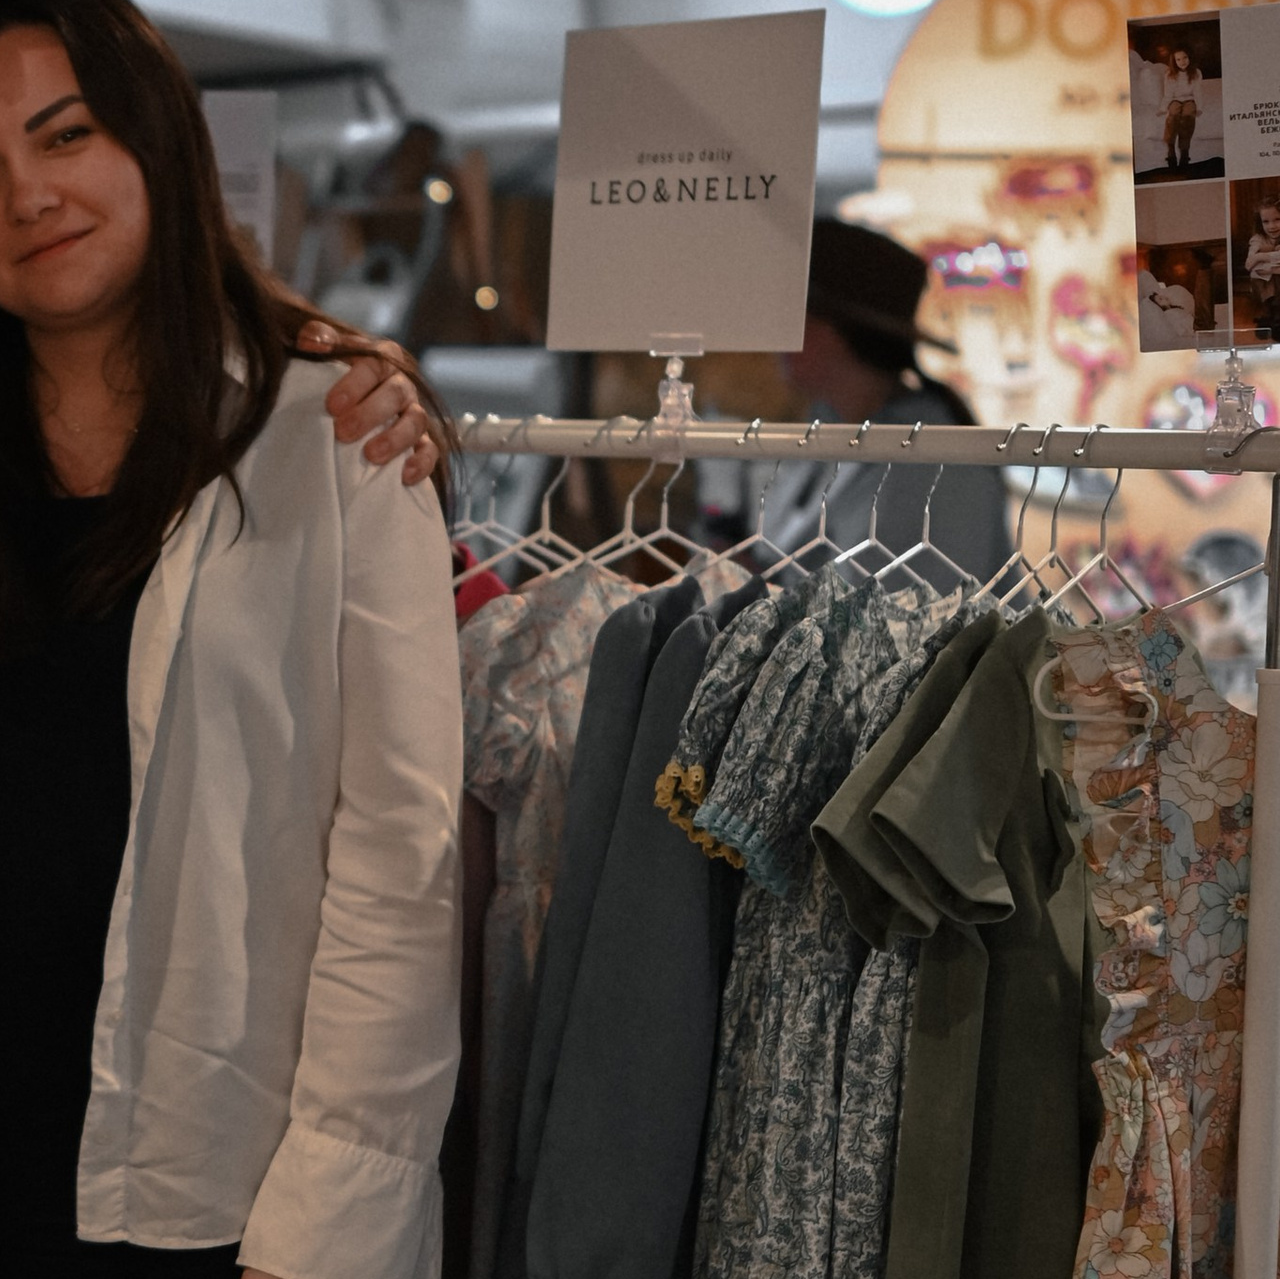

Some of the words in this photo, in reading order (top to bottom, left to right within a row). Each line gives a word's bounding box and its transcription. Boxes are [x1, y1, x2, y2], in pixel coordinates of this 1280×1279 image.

[1261, 126, 1280, 134] БЕЖ
[637, 150, 673, 165] dress
[678, 150, 695, 164] up
[699, 147, 733, 162] daily
[590, 174, 777, 205] LEO&NELLY
